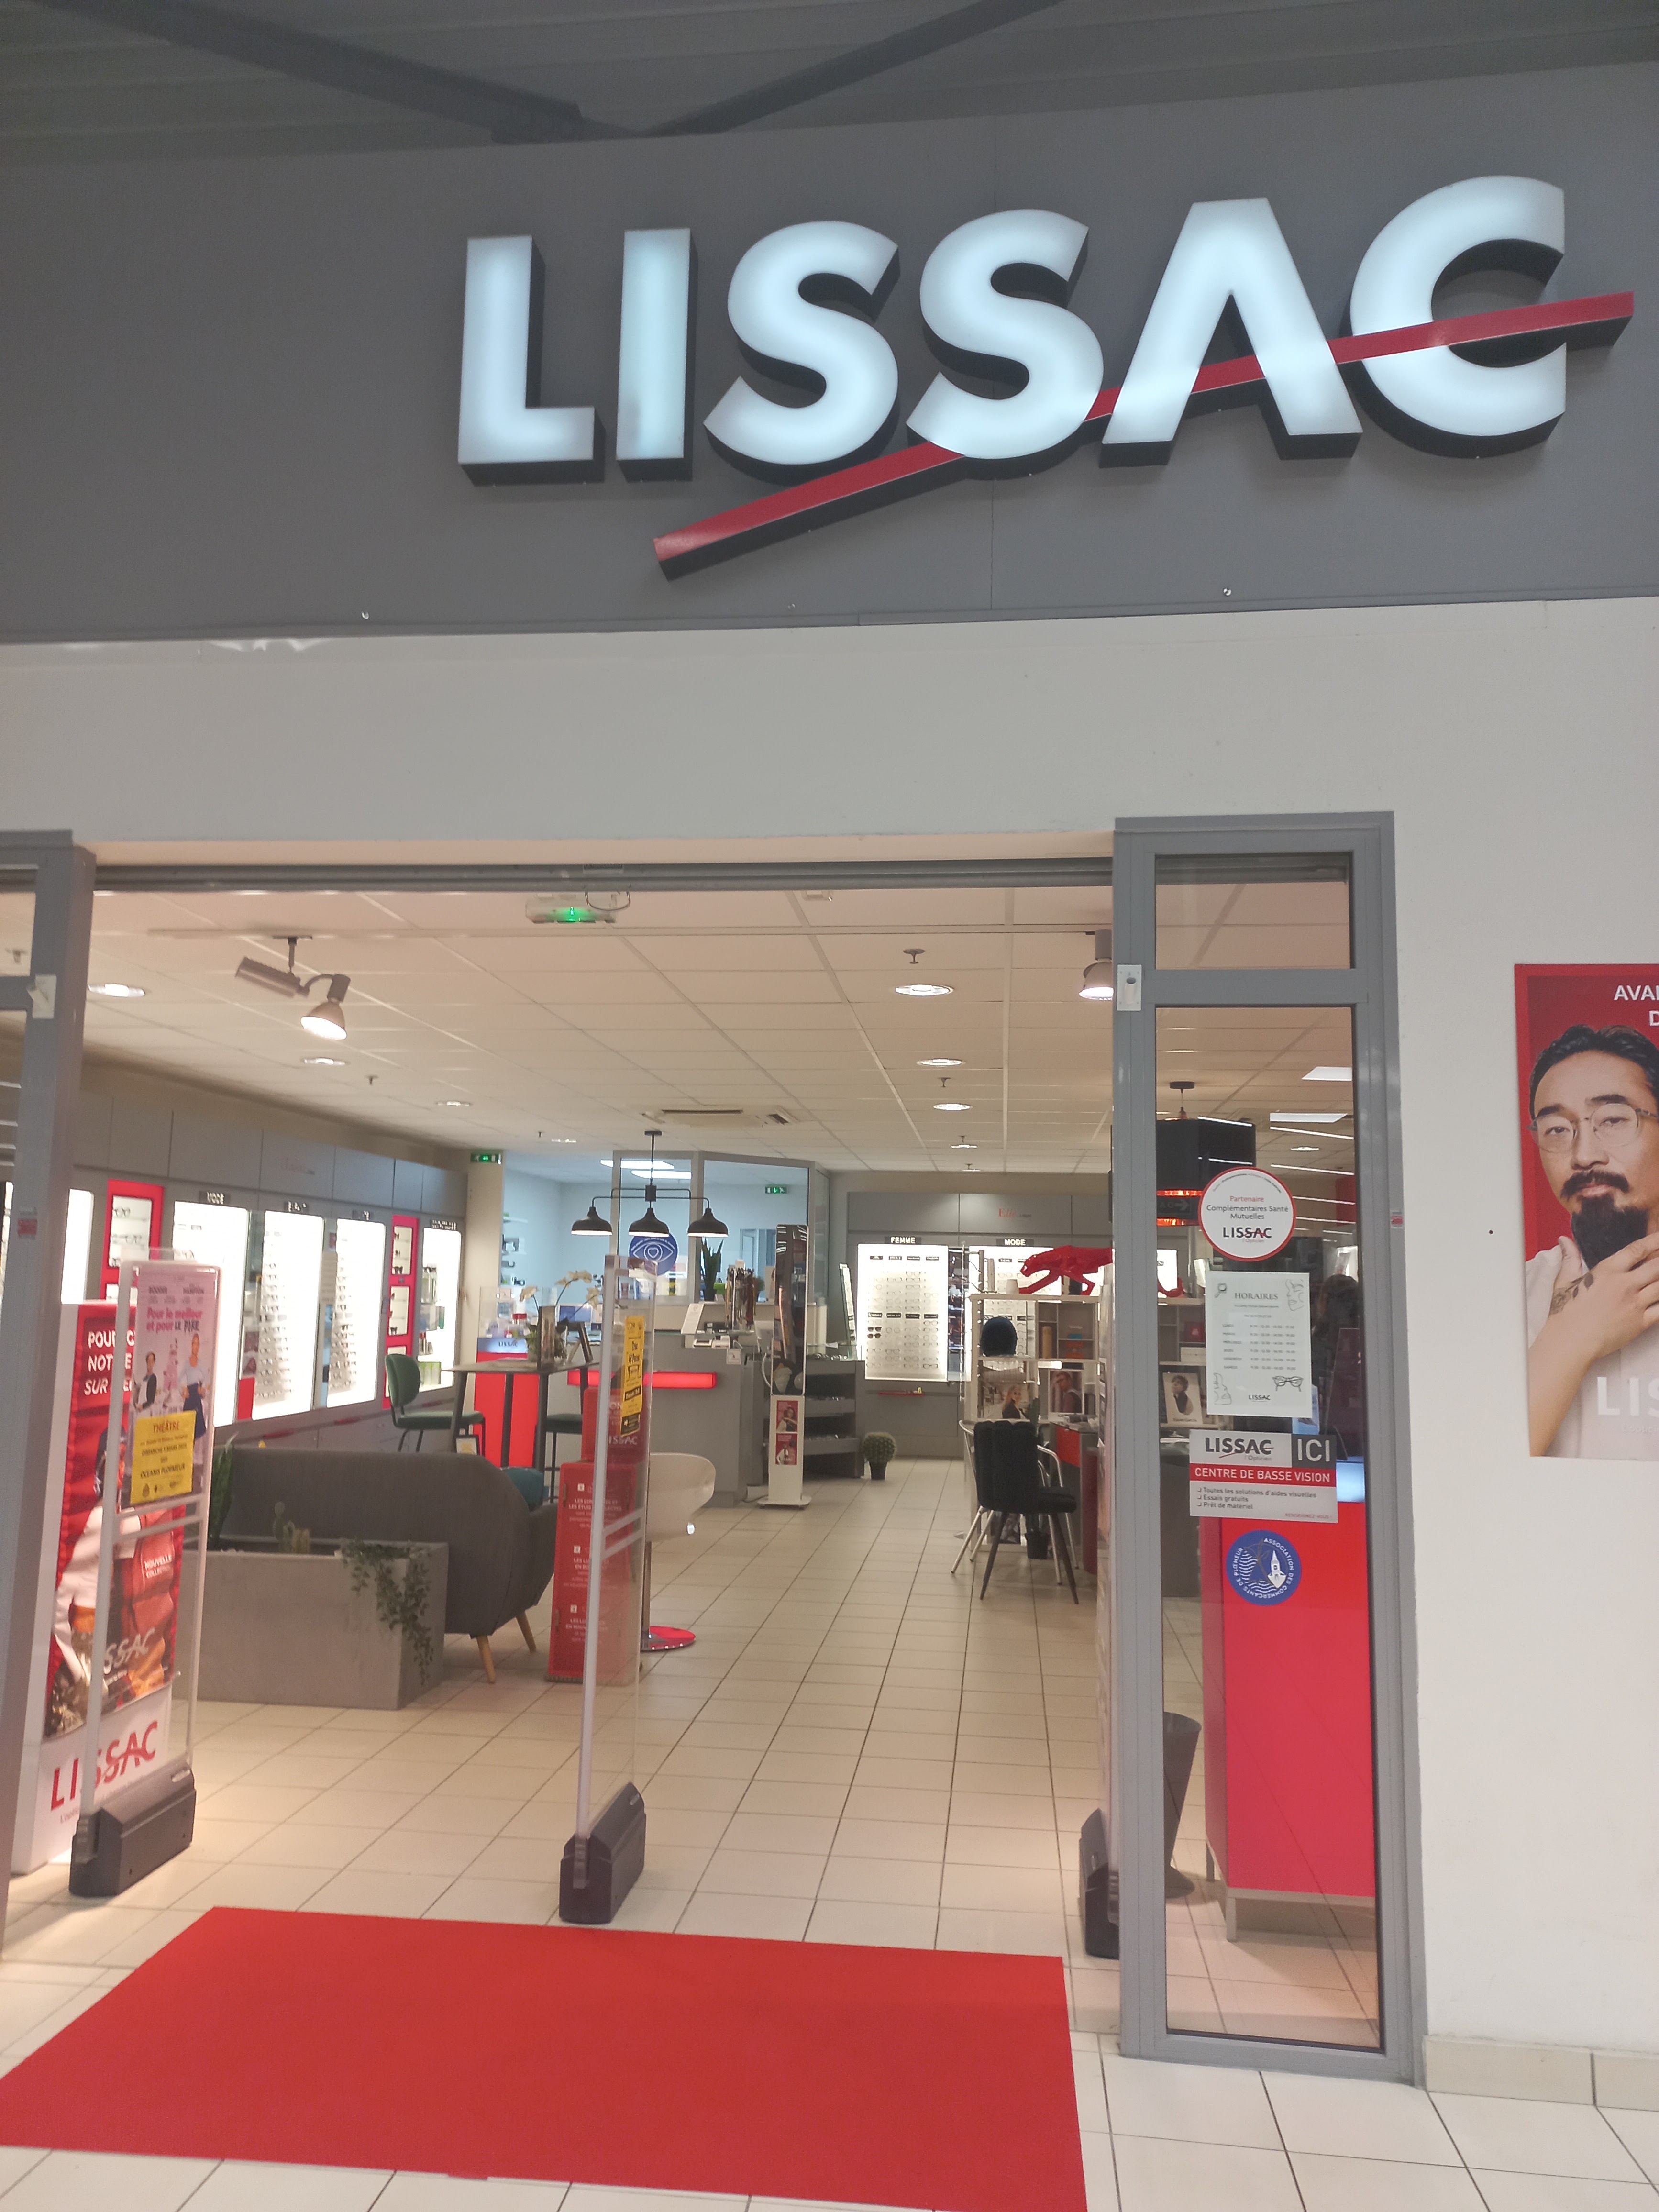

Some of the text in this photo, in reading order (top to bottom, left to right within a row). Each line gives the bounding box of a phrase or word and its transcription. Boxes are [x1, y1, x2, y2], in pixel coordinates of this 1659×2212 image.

[457, 174, 1569, 474] LISSAC
[1206, 1205, 1267, 1213] Complémentaires
[1222, 1227, 1272, 1239] LISSAC
[890, 1236, 916, 1244] FEMME
[1004, 1238, 1026, 1246] MODE
[1234, 1292, 1279, 1300] HORAIRES
[147, 1307, 164, 1319] Pour
[166, 1308, 173, 1319] le
[146, 1322, 155, 1331] et
[156, 1322, 174, 1334] pour
[88, 1353, 132, 1372] NOTE
[84, 1377, 108, 1396] SUR
[608, 1436, 638, 1445] ISSAC
[1205, 1437, 1273, 1456] LISSAC
[1297, 1438, 1330, 1462] ICI
[1194, 1467, 1330, 1482] CENTRE DE BASSE VISION
[1264, 1538, 1294, 1571] ASSOCIATION
[1236, 1578, 1244, 1586] DE
[51, 1721, 158, 1812] LISAC
